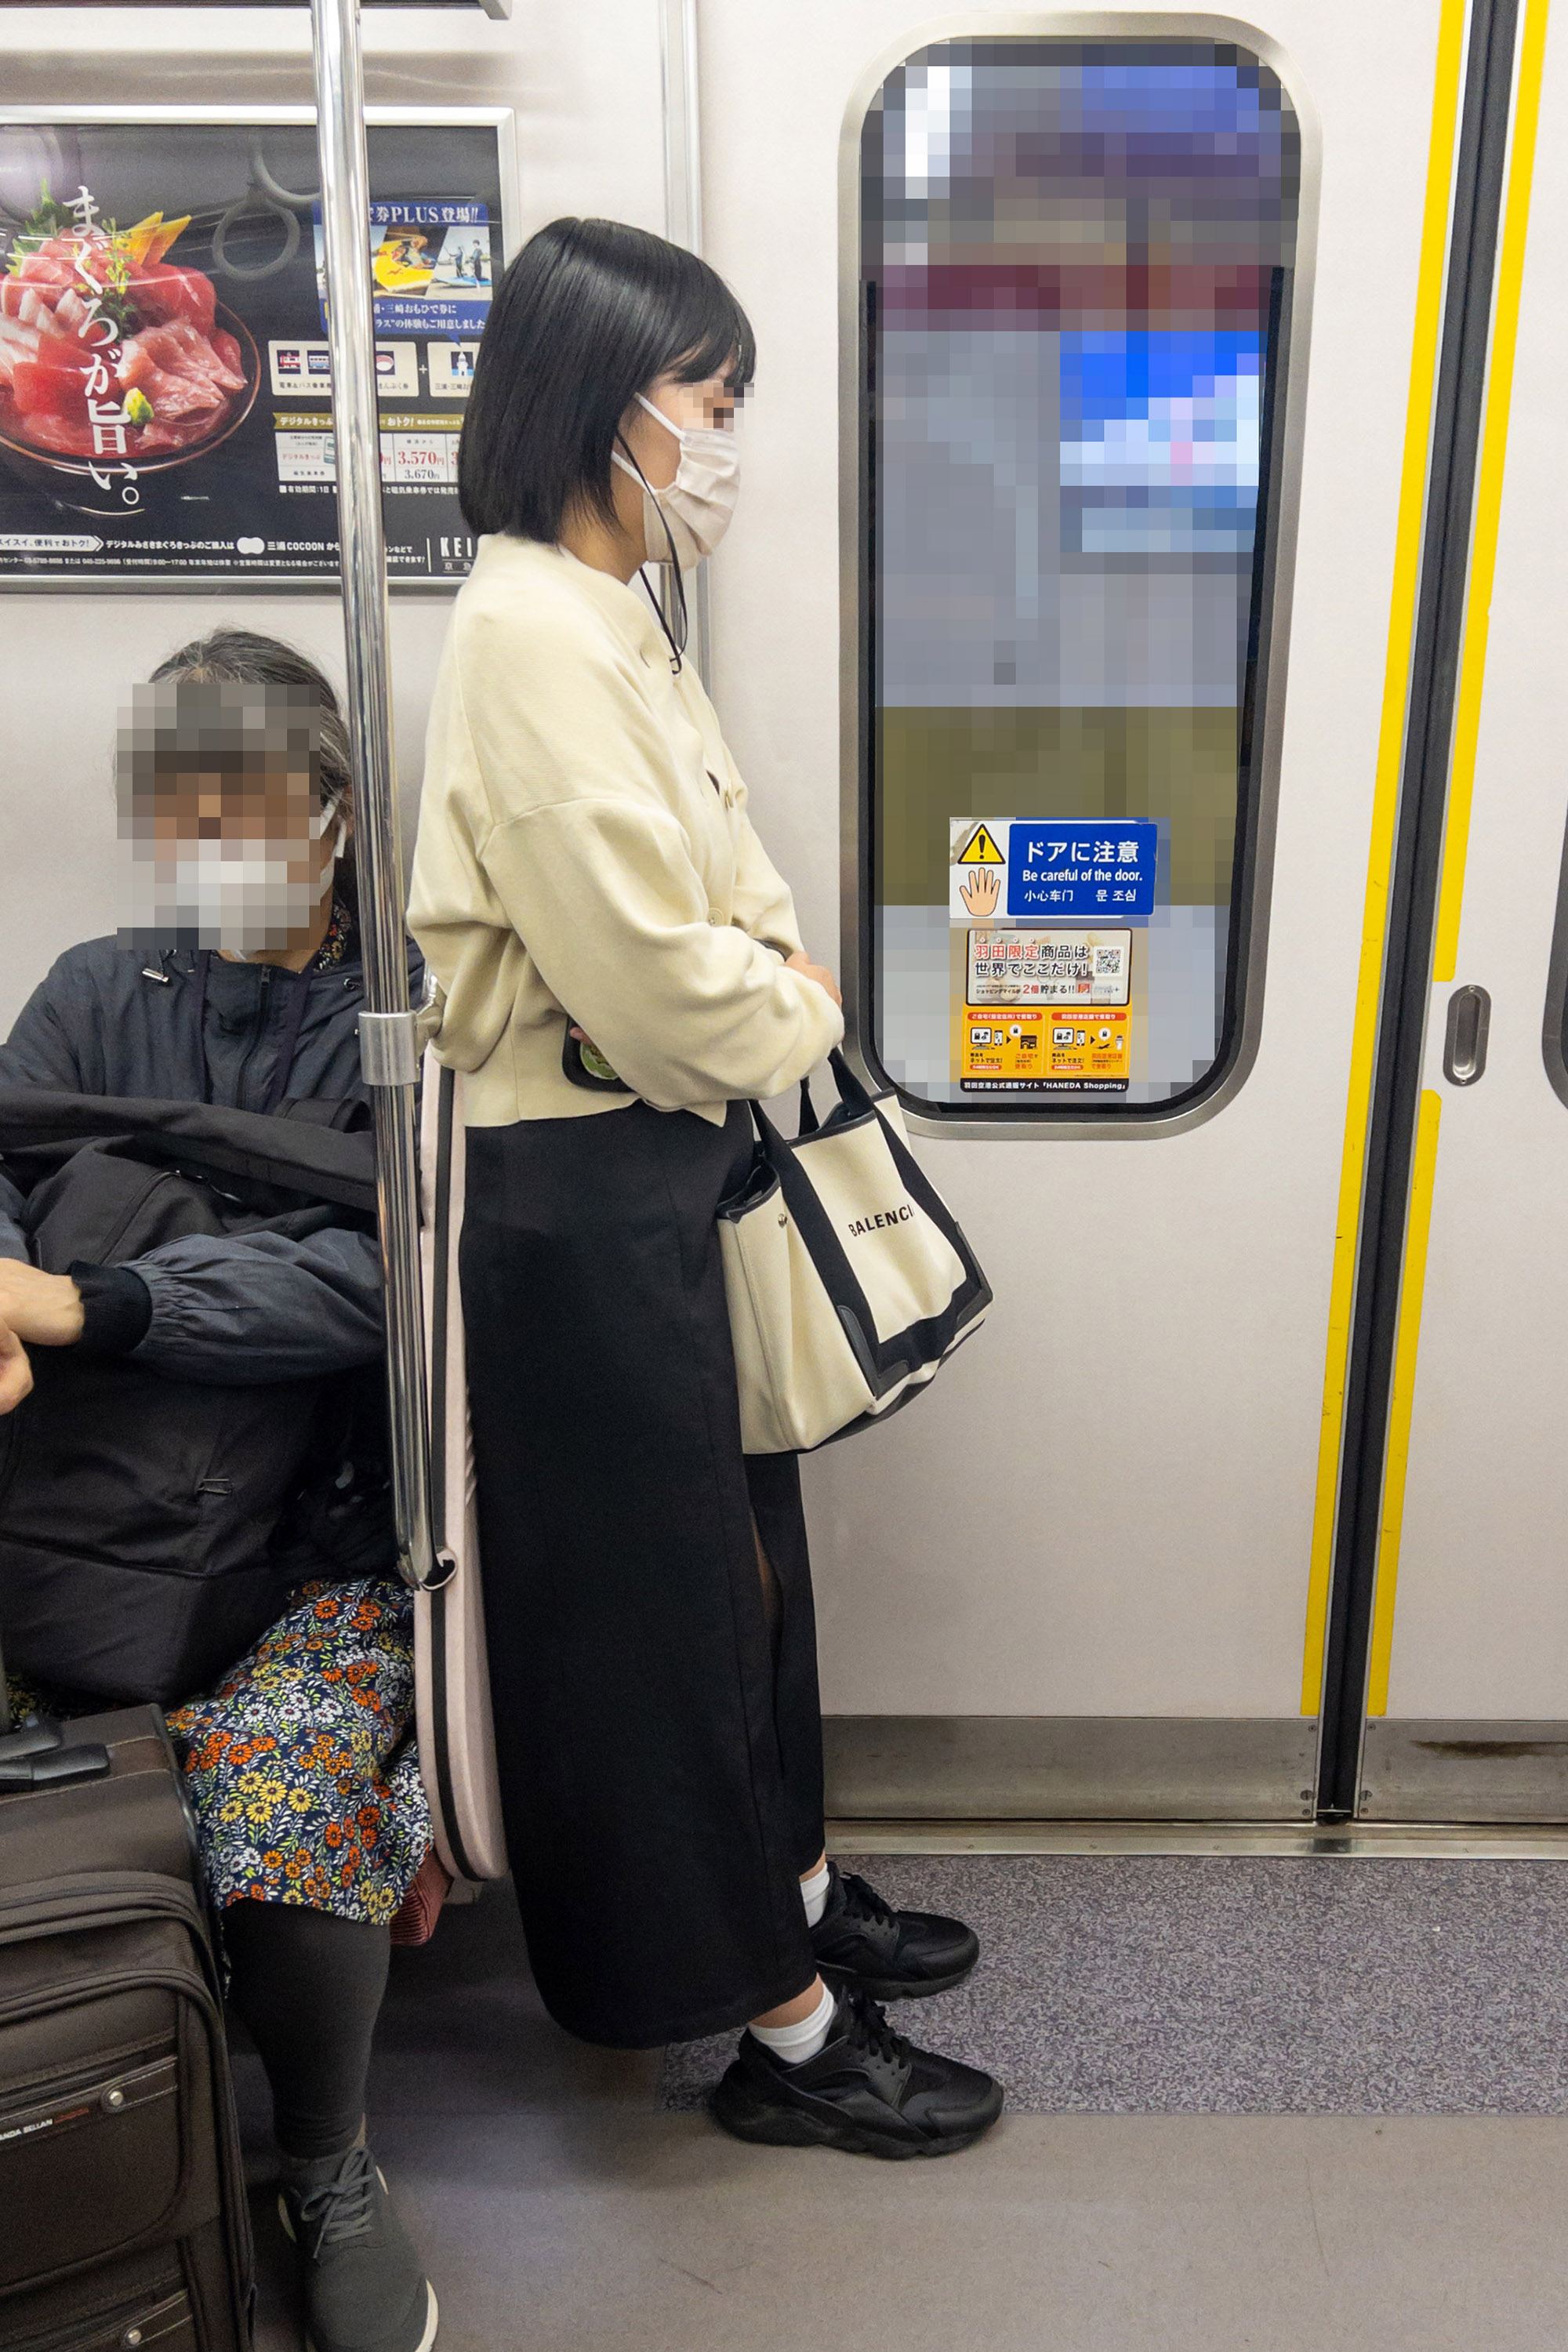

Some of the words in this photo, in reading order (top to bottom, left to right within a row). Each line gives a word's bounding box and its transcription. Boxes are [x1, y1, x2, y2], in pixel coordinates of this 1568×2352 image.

[64, 187, 140, 506] まぐろが旨い。
[1026, 840, 1140, 863] ドアに注意
[1022, 869, 1038, 882] Be
[1040, 869, 1078, 882] careful
[1081, 869, 1094, 882] of
[1094, 869, 1112, 881] the
[1114, 869, 1143, 882] door.
[1024, 889, 1074, 902] 小心车门
[1096, 889, 1109, 902] 문
[1112, 889, 1137, 902] 조심
[975, 945, 1088, 959] 羽田限定商品は
[975, 962, 1087, 976] 世界でここだけ!
